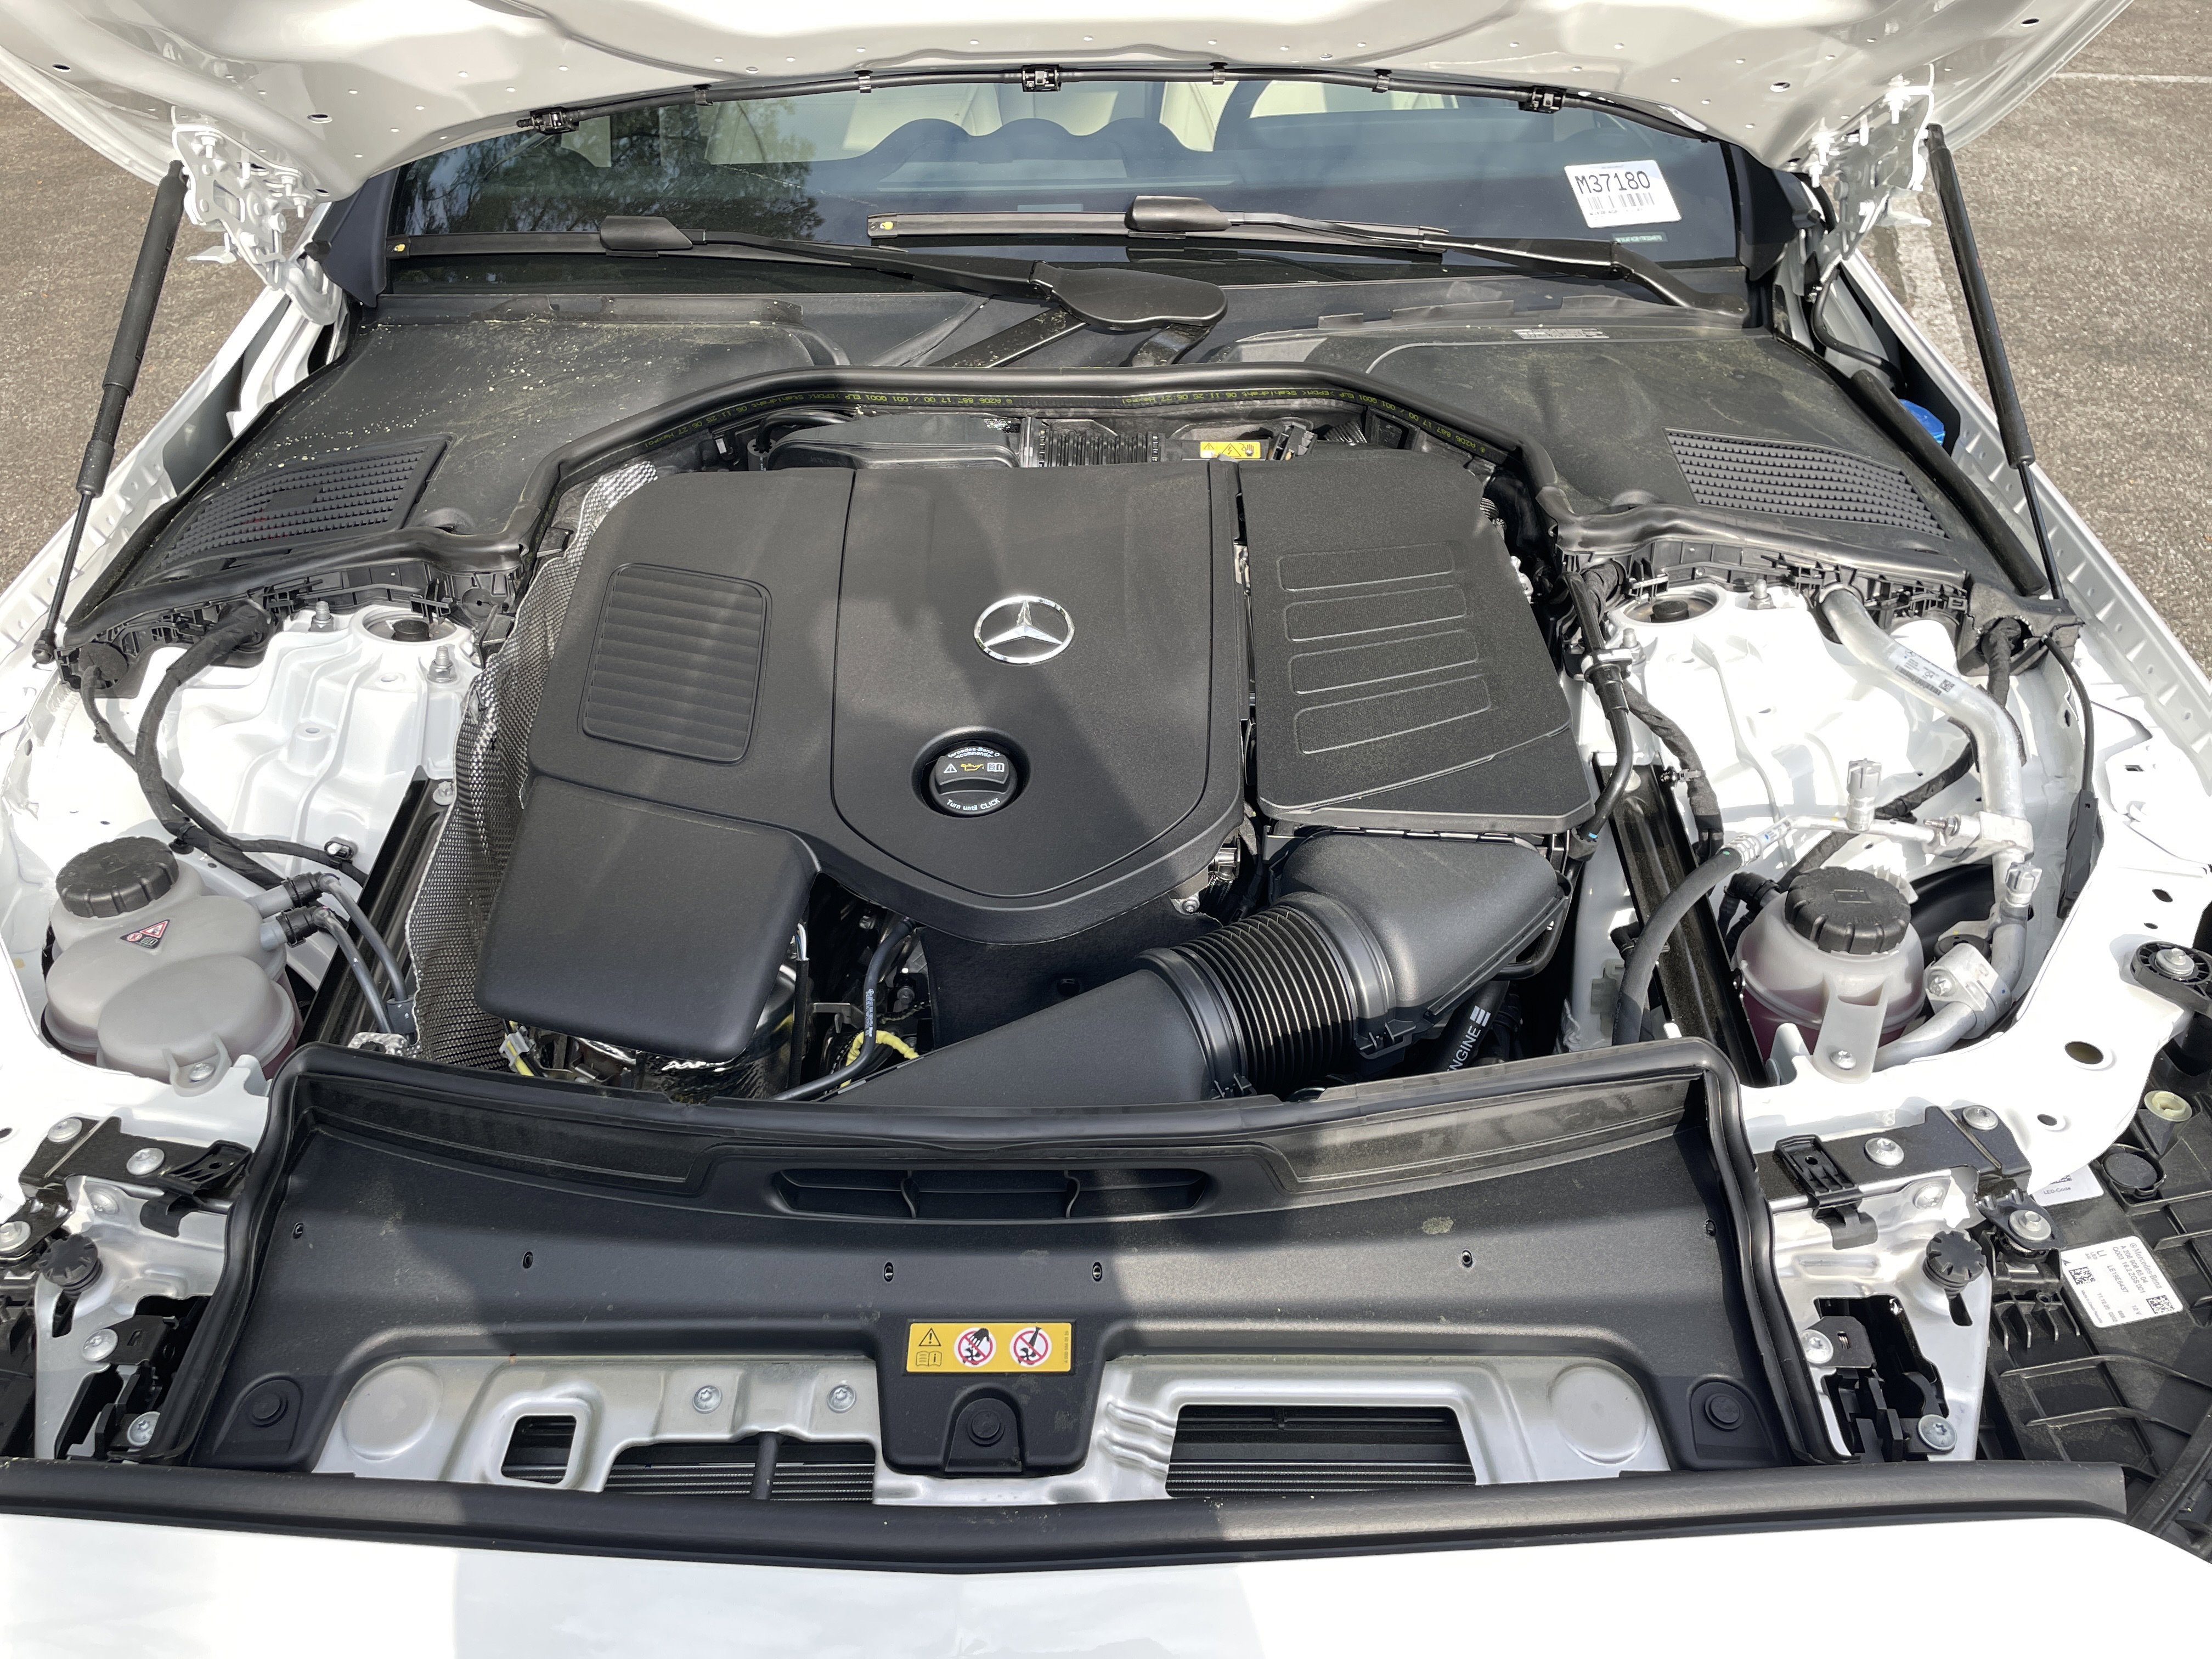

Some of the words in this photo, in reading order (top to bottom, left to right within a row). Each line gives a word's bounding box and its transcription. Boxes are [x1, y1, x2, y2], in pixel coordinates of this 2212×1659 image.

[1575, 171, 1651, 194] M37180
[946, 799, 961, 810] Turn
[980, 797, 1001, 810] CLICK
[1447, 1025, 1481, 1071] NGINE
[2132, 1248, 2163, 1289] Mercedes-Benz
